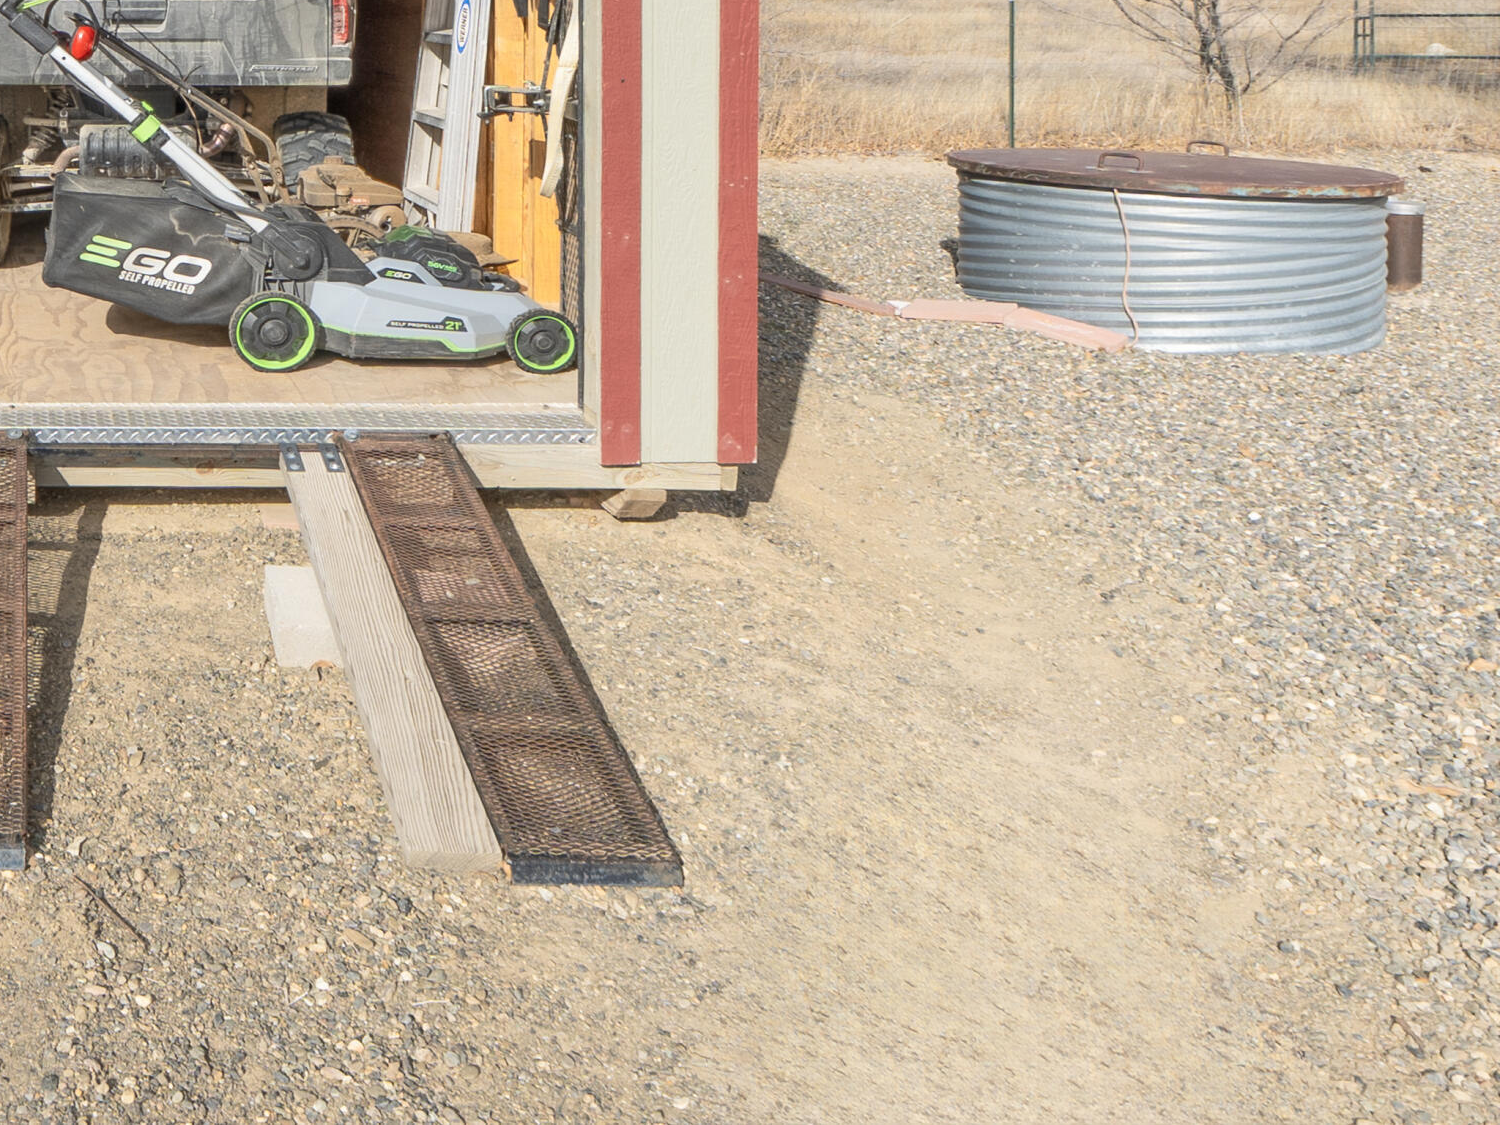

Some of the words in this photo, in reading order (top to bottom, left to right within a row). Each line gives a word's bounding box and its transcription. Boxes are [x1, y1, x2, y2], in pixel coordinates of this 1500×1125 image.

[459, 7, 469, 44] WERNER
[80, 234, 213, 286] EGO
[385, 270, 413, 280] EGO
[118, 270, 142, 284] SELF
[141, 274, 196, 295] PROPELLED
